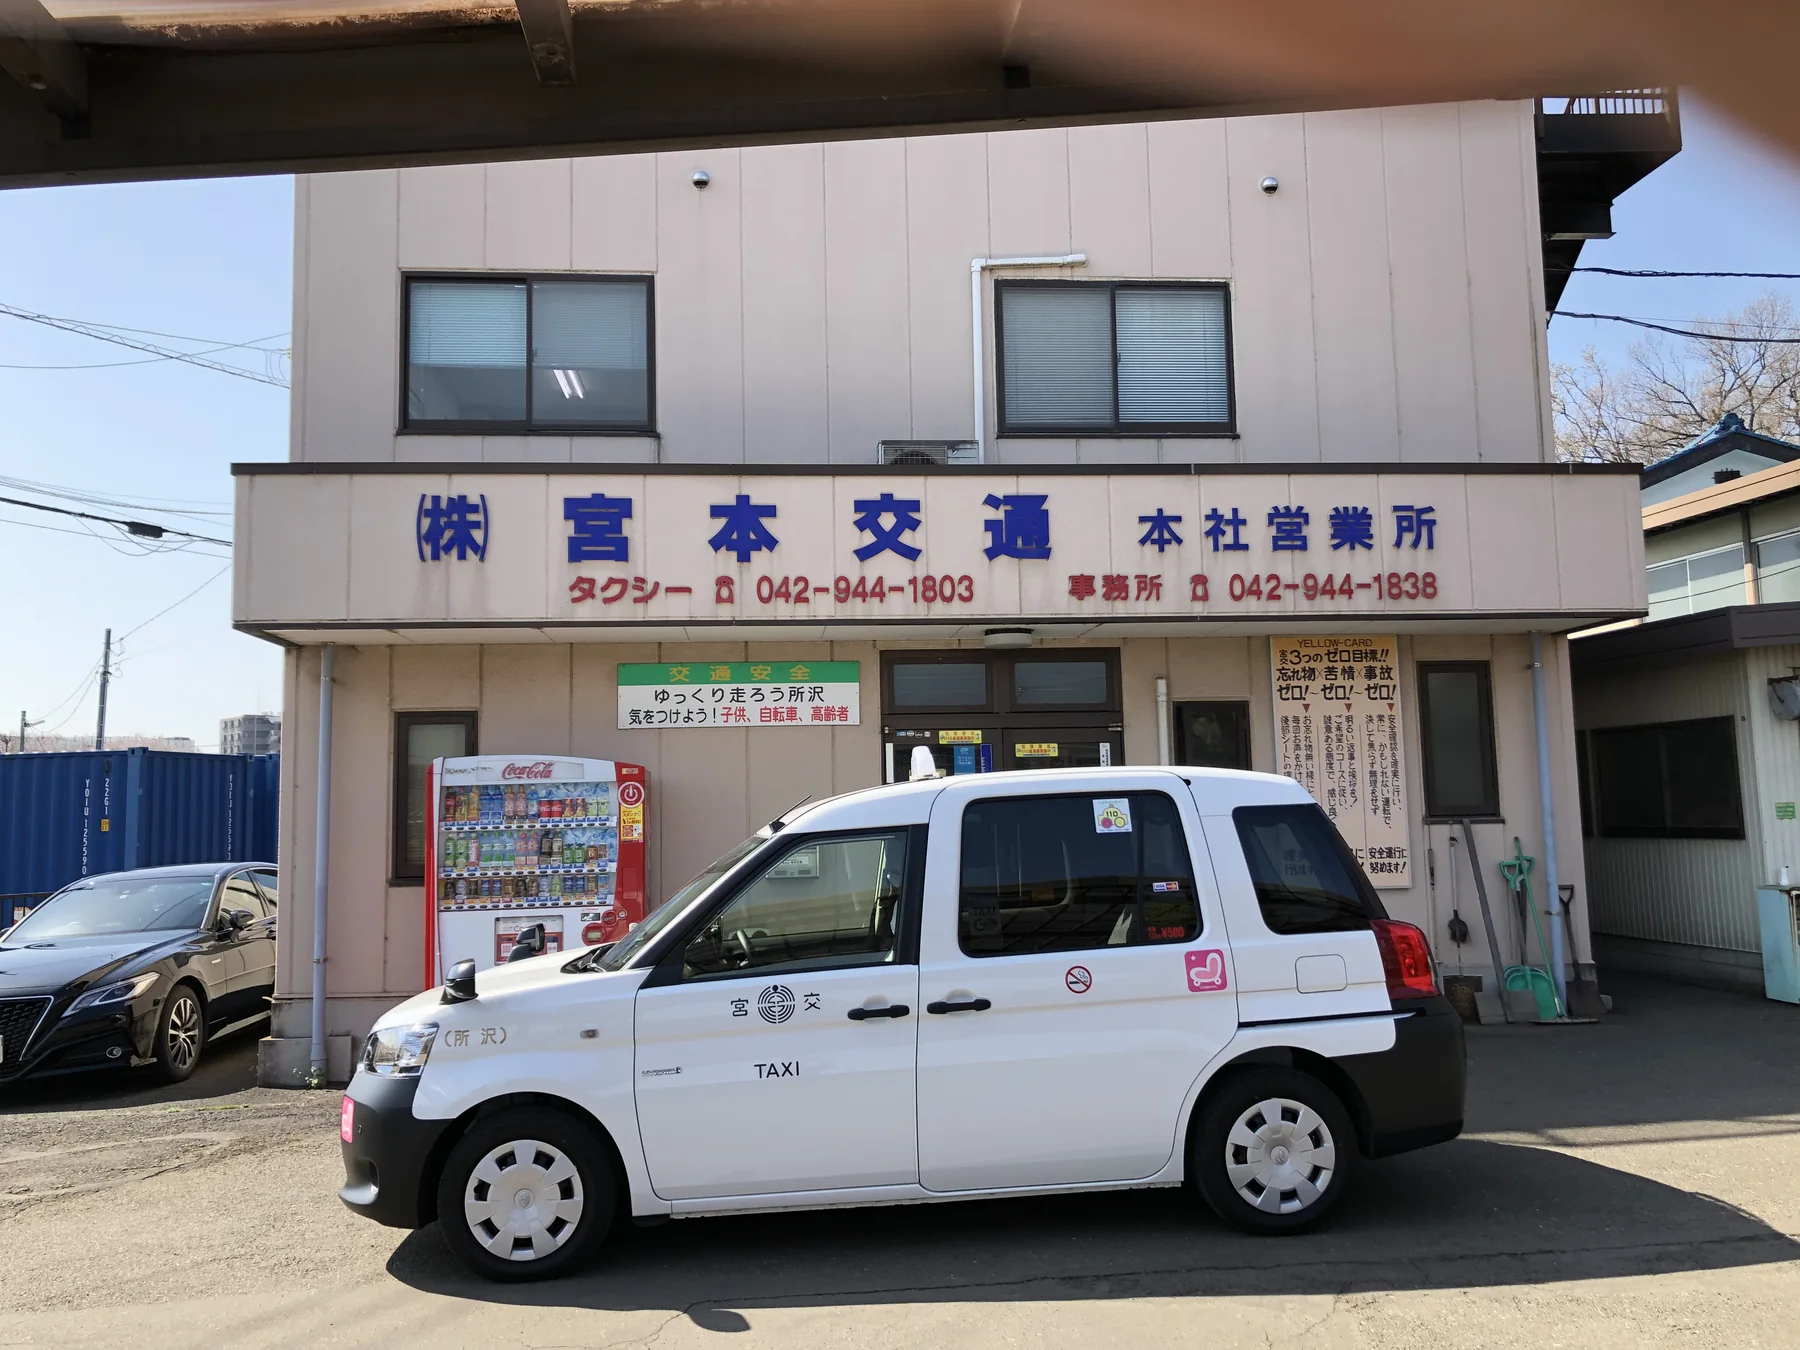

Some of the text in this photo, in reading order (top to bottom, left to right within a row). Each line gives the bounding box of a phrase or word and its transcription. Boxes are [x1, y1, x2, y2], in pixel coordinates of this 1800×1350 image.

[1138, 504, 1438, 555] 本社営業所
[569, 575, 975, 605] タクシー 042-944-1803
[1068, 571, 1438, 602] 事務所 042-944-1838
[1297, 639, 1372, 648] YELLOW-CARD
[669, 664, 810, 682] 交通安全
[654, 685, 825, 705] ゆっくり走ろう所沢
[1291, 715, 1303, 783] 毎回お声をかけ
[502, 761, 555, 780] Coca-Cola
[81, 818, 89, 875] 125590
[1368, 846, 1408, 860] 安全運行に
[1370, 861, 1407, 874] 努めます!
[730, 992, 821, 1017] 宮 交
[753, 1060, 800, 1079] TAXI
